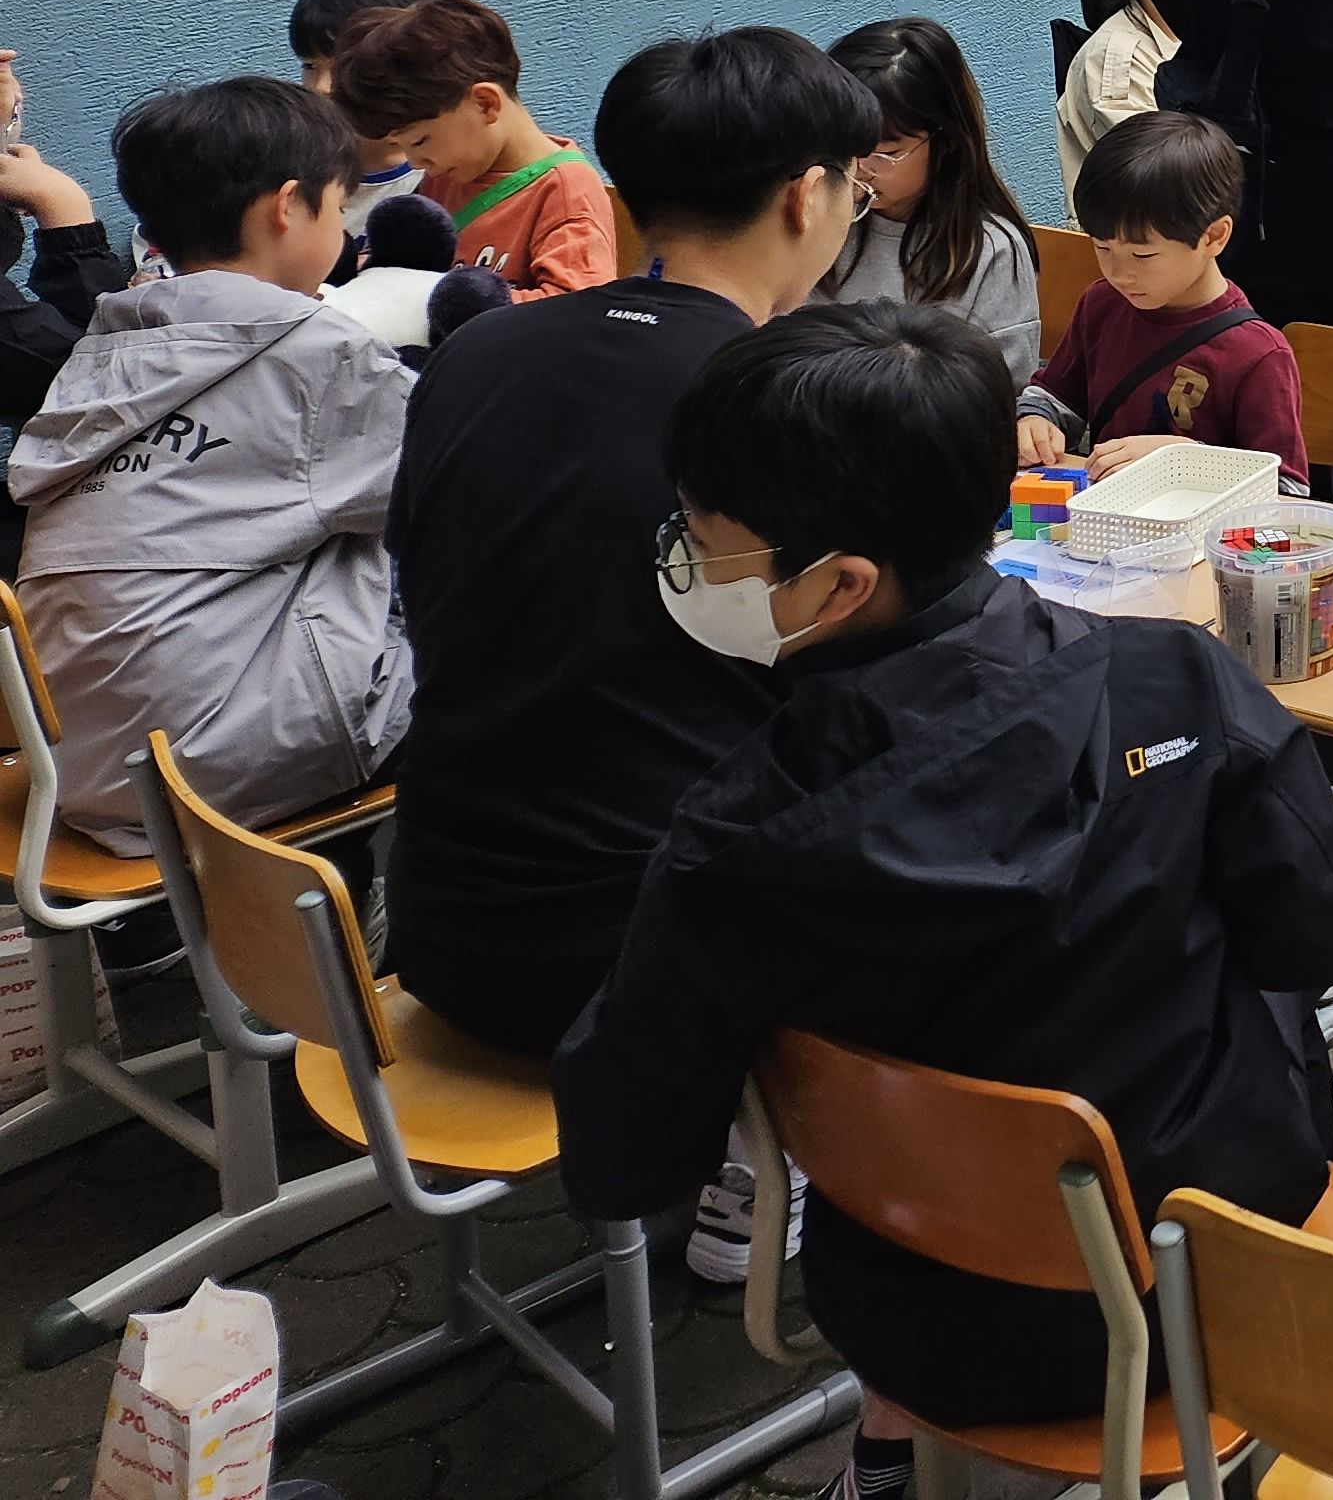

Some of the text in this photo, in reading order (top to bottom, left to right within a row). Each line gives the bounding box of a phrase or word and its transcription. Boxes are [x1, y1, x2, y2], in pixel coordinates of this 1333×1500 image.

[606, 309, 660, 325] KANGOL
[1144, 736, 1189, 758] NATIONAL
[211, 1366, 273, 1415] popcorn
